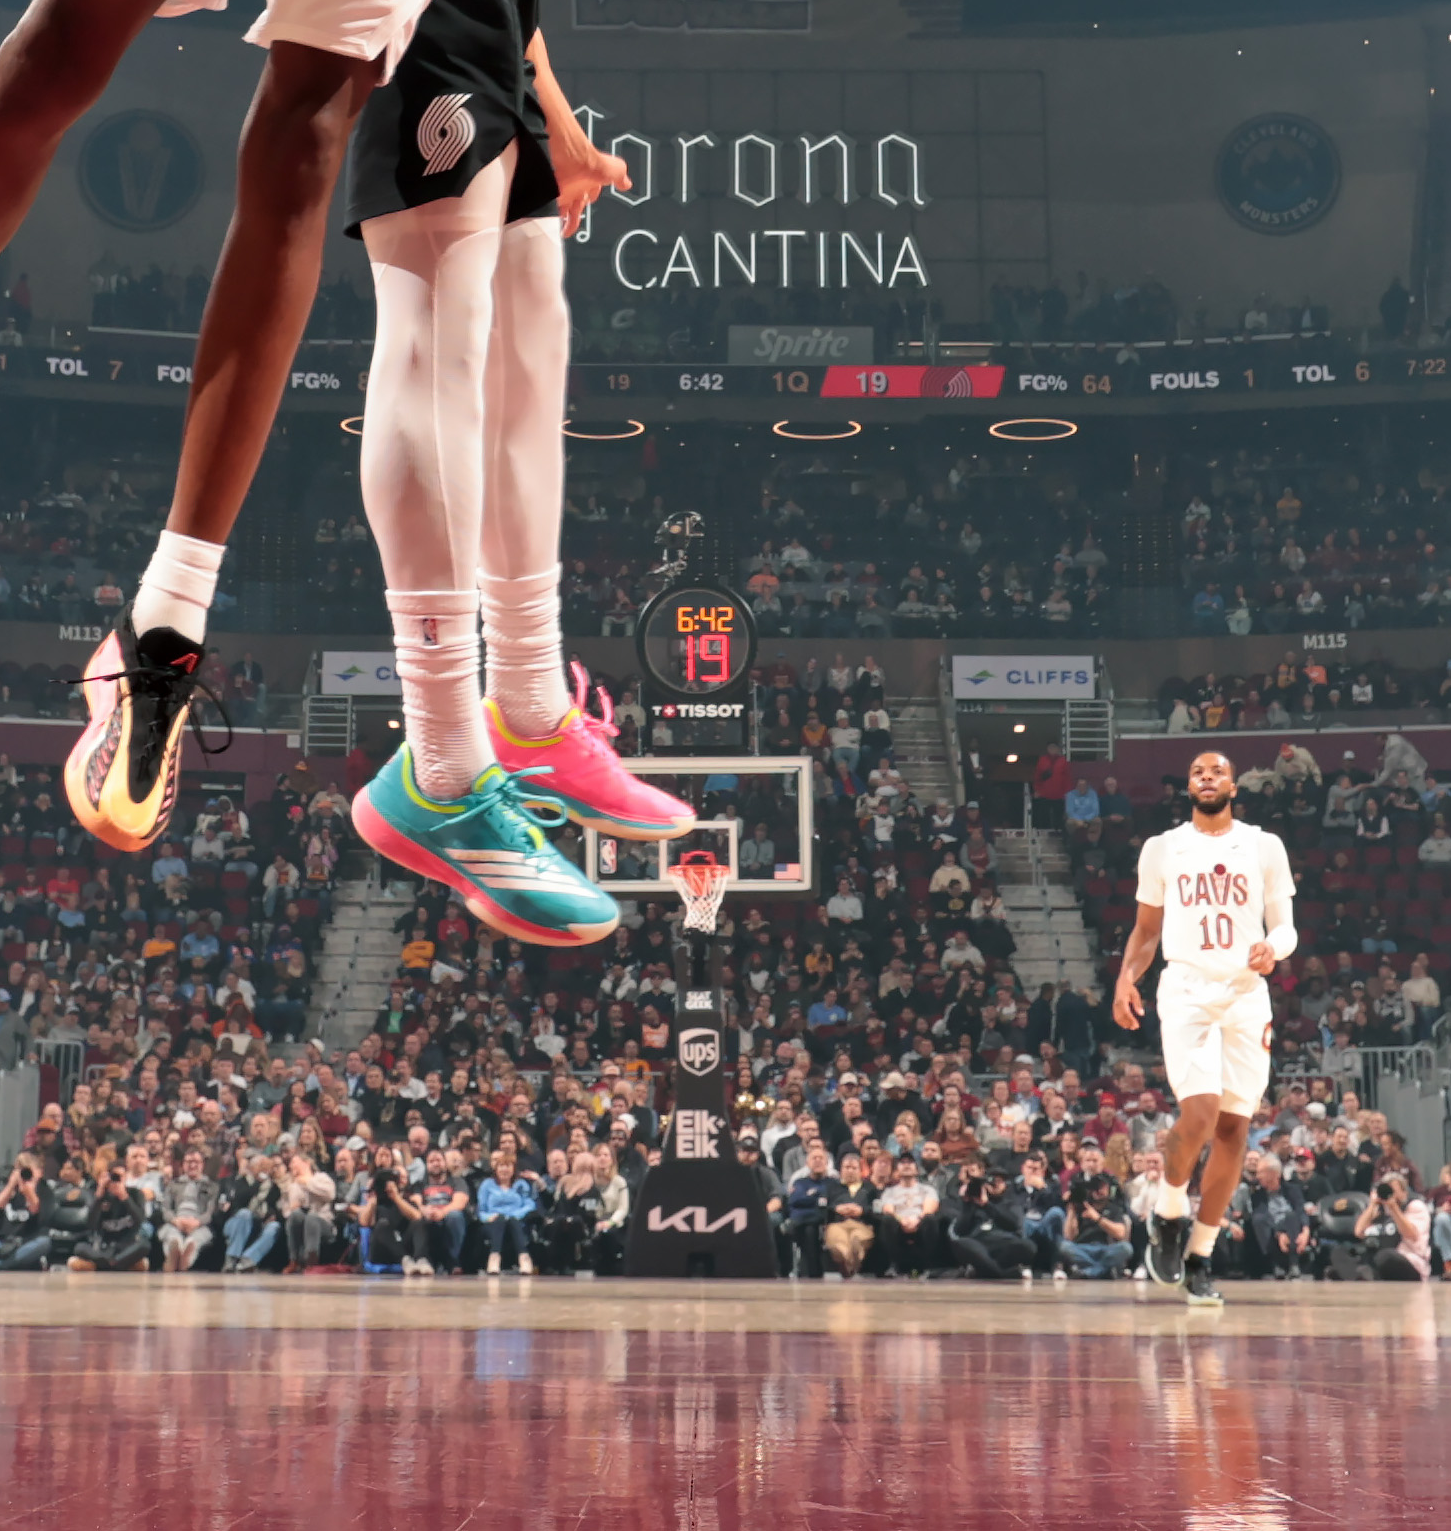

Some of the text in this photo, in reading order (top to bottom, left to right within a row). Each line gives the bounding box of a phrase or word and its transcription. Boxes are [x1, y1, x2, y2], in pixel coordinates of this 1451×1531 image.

[1239, 196, 1319, 225] MONSTERS
[613, 228, 931, 291] CANTINA
[753, 325, 850, 363] Sprite
[46, 356, 89, 377] TOL
[109, 359, 124, 381] 7
[291, 371, 341, 390] FG%
[606, 373, 632, 391] 19
[678, 372, 724, 392] 6:42
[772, 371, 810, 395] 1Q
[855, 371, 890, 396] 19
[1018, 373, 1068, 393] FG%
[1082, 374, 1113, 395] 64
[1150, 370, 1220, 391] FOULS
[1244, 369, 1256, 389] 1
[1292, 364, 1336, 384] TOL
[1354, 361, 1372, 382] 6
[1406, 357, 1447, 377] 7:22
[676, 606, 735, 632] 6:42
[59, 625, 103, 642] M113
[1303, 632, 1348, 651] M115
[686, 634, 731, 682] 19
[1006, 669, 1089, 685] CLIFFS
[676, 703, 745, 718] TISSOT
[1177, 872, 1248, 907] CAVS
[1198, 912, 1234, 951] 10
[685, 990, 712, 1002] SEAT
[685, 1000, 713, 1010] GEEK
[682, 1042, 716, 1069] ups
[676, 1134, 720, 1159] Elk
